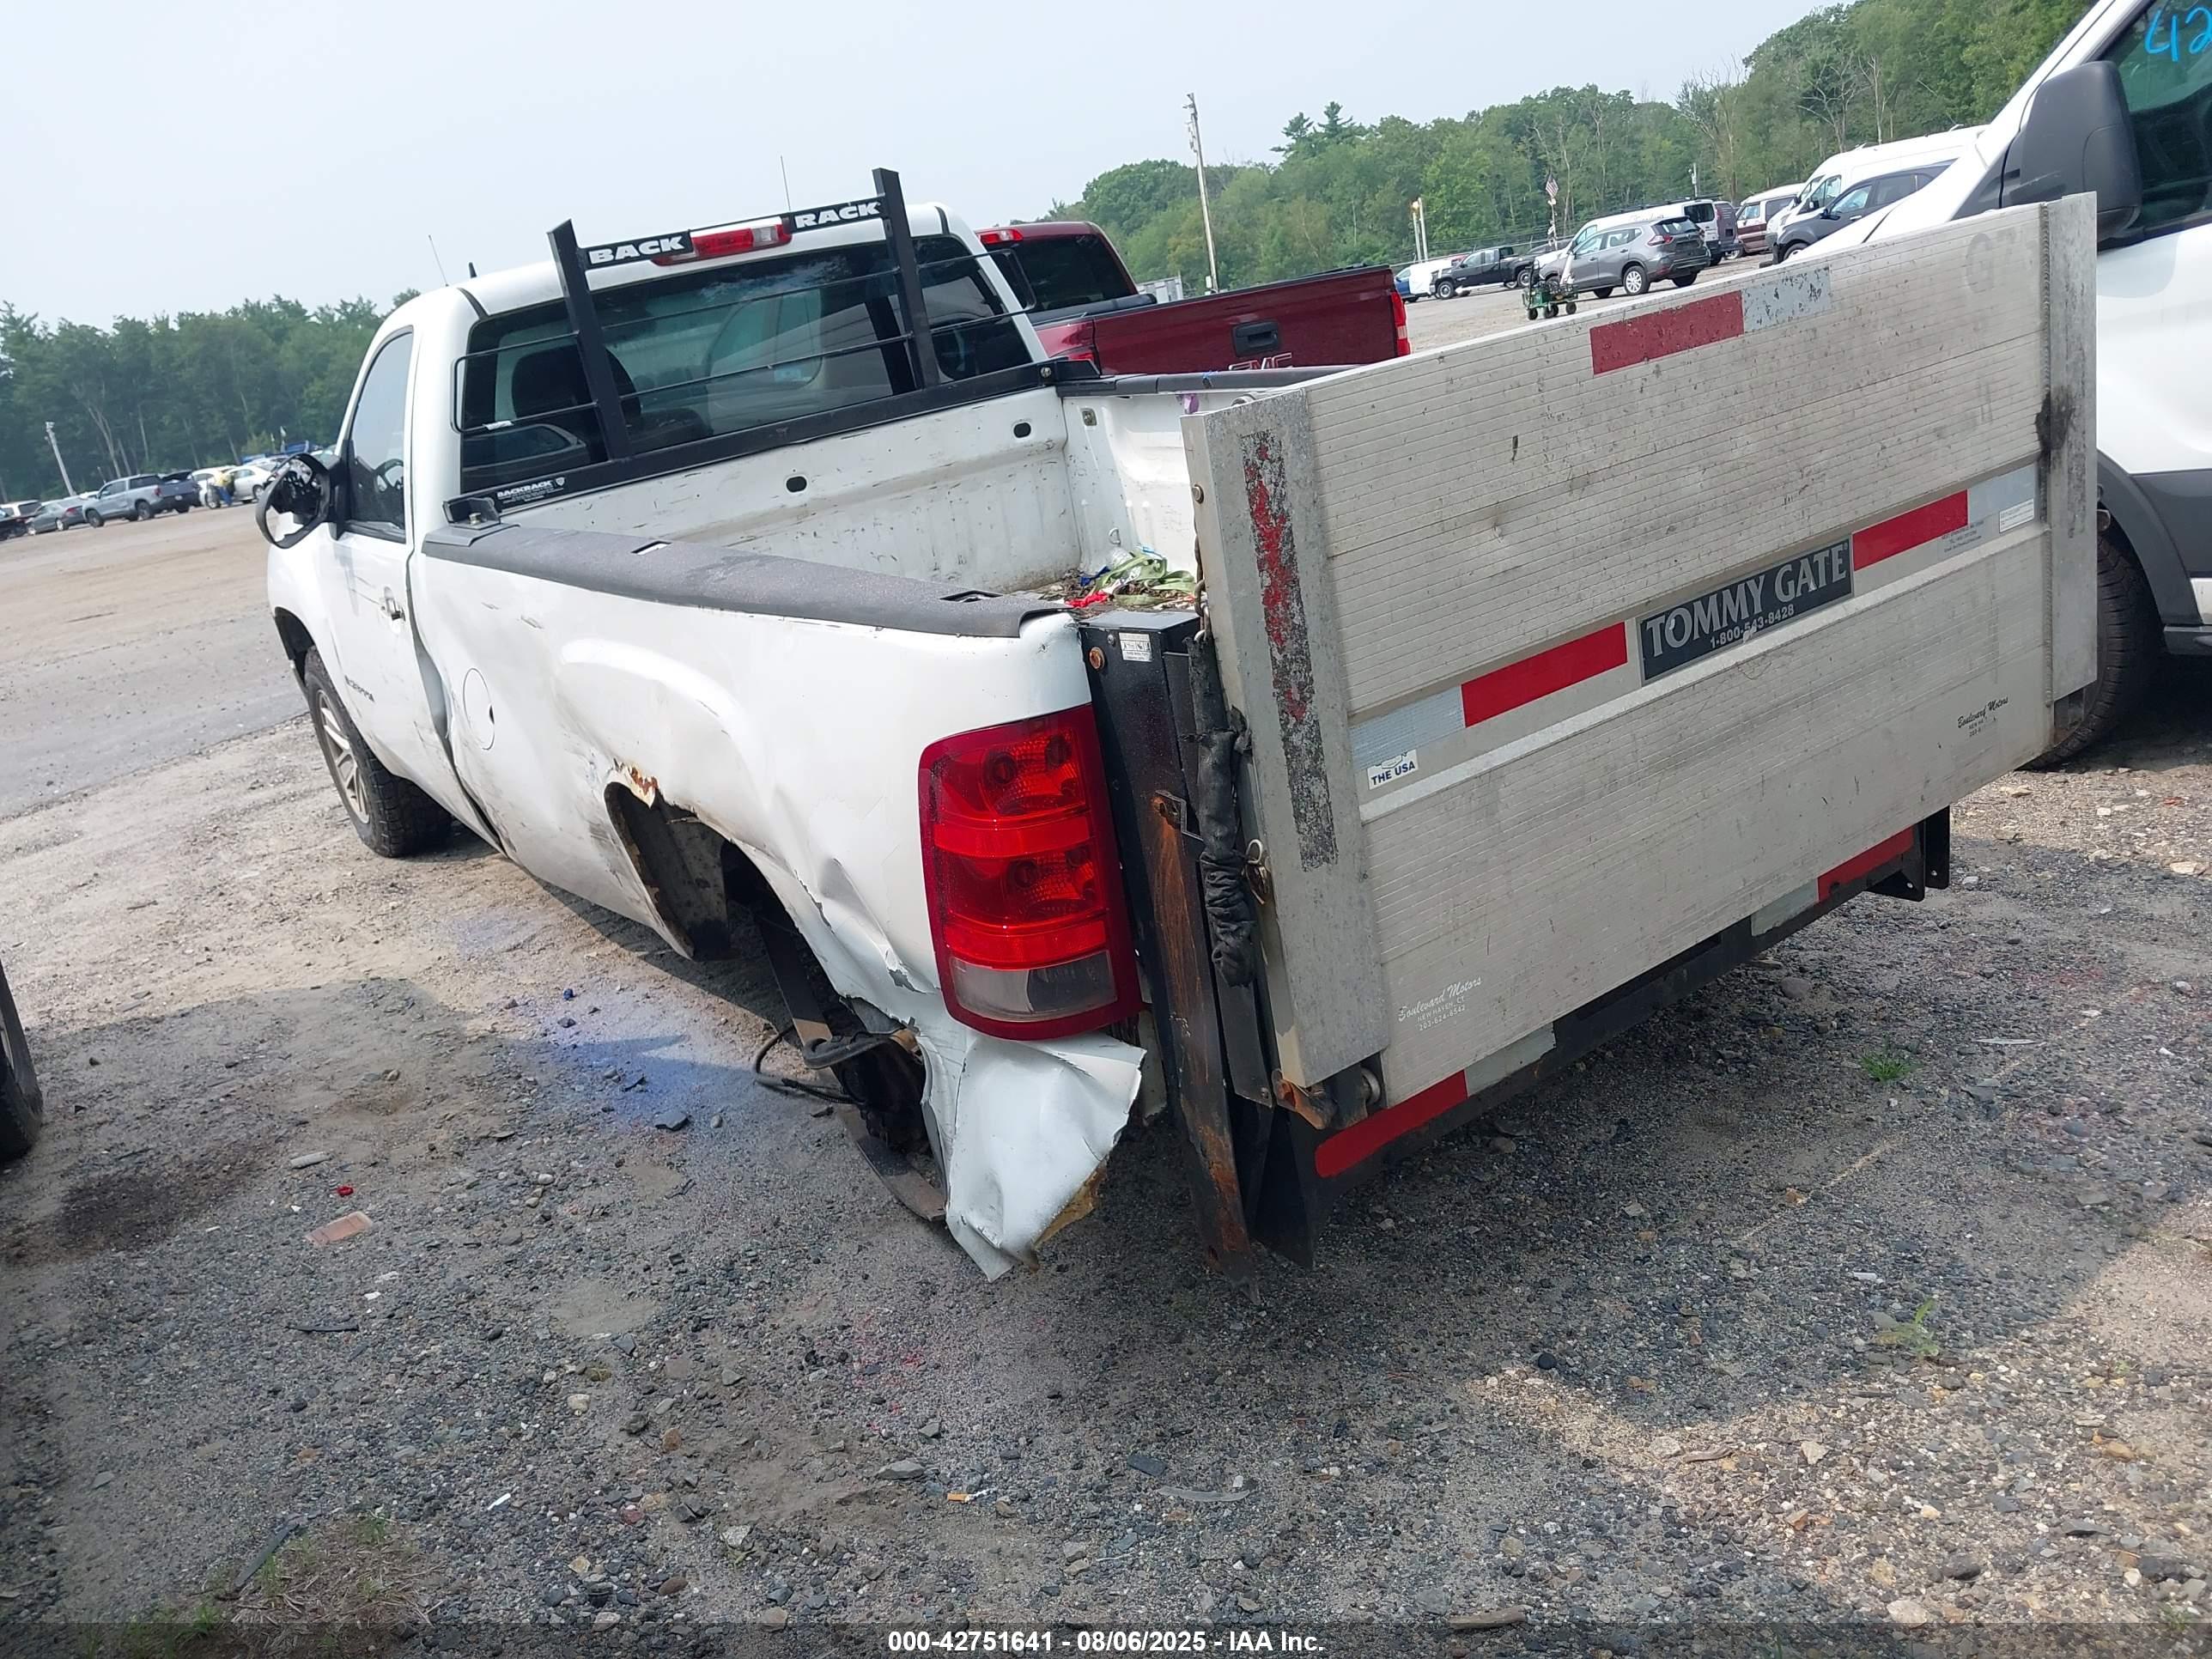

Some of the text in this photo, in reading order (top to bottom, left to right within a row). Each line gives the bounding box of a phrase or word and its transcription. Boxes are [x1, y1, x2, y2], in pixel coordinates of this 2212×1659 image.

[588, 201, 880, 264] BACK RACK
[496, 480, 552, 498] BACKRACK
[1646, 544, 1847, 658] TOMMY GATE
[1370, 761, 1415, 785] THE USA
[1397, 976, 1482, 1023] Boulevard Motors
[1416, 1011, 1432, 1023] NEW
